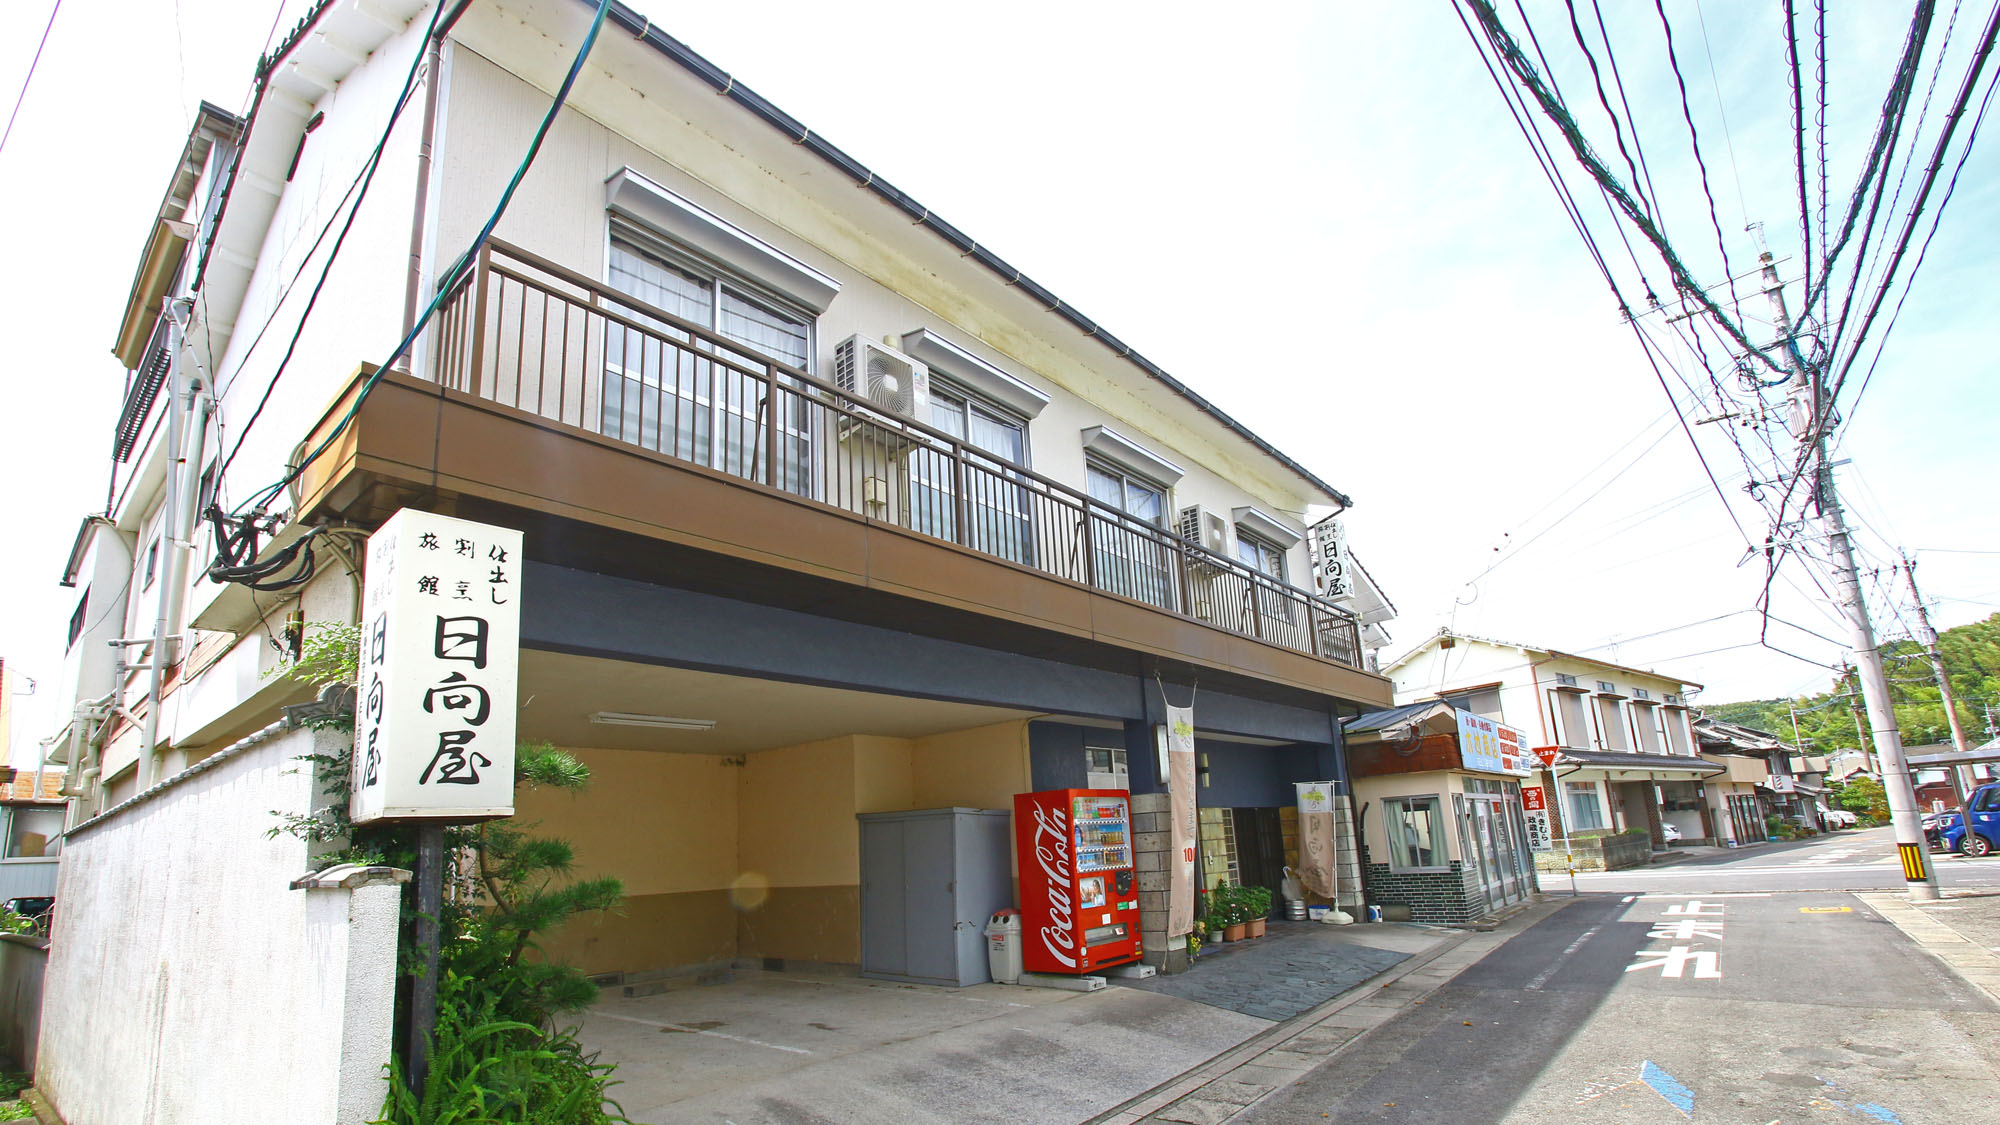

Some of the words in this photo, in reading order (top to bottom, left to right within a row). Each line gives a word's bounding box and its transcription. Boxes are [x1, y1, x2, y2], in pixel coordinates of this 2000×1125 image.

[418, 532, 440, 597] 旅館
[452, 537, 475, 602] 割烹
[488, 543, 508, 605] 仕出し
[1324, 541, 1346, 597] 日向屋
[362, 610, 387, 790] 日向屋
[419, 615, 491, 785] 日向屋
[1033, 800, 1076, 968] Coca-Cola
[1625, 900, 1725, 978] 止まれ
